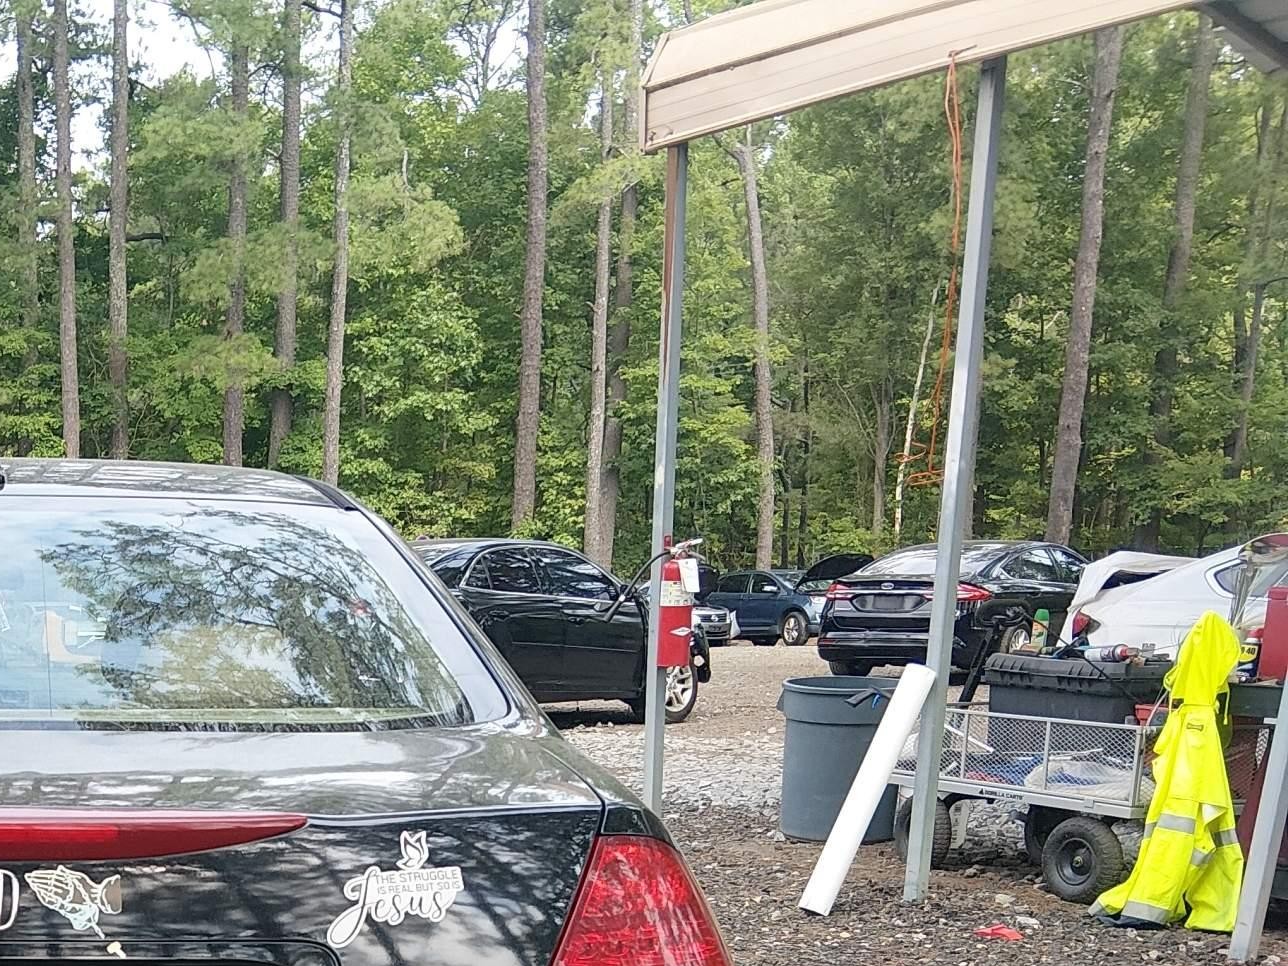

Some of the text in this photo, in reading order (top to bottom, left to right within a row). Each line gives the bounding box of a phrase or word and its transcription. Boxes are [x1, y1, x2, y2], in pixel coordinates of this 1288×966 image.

[376, 869, 459, 885] THE STRUGGLE
[377, 880, 461, 895] IS REAL BUT SO IS
[329, 867, 447, 945] Jesus
